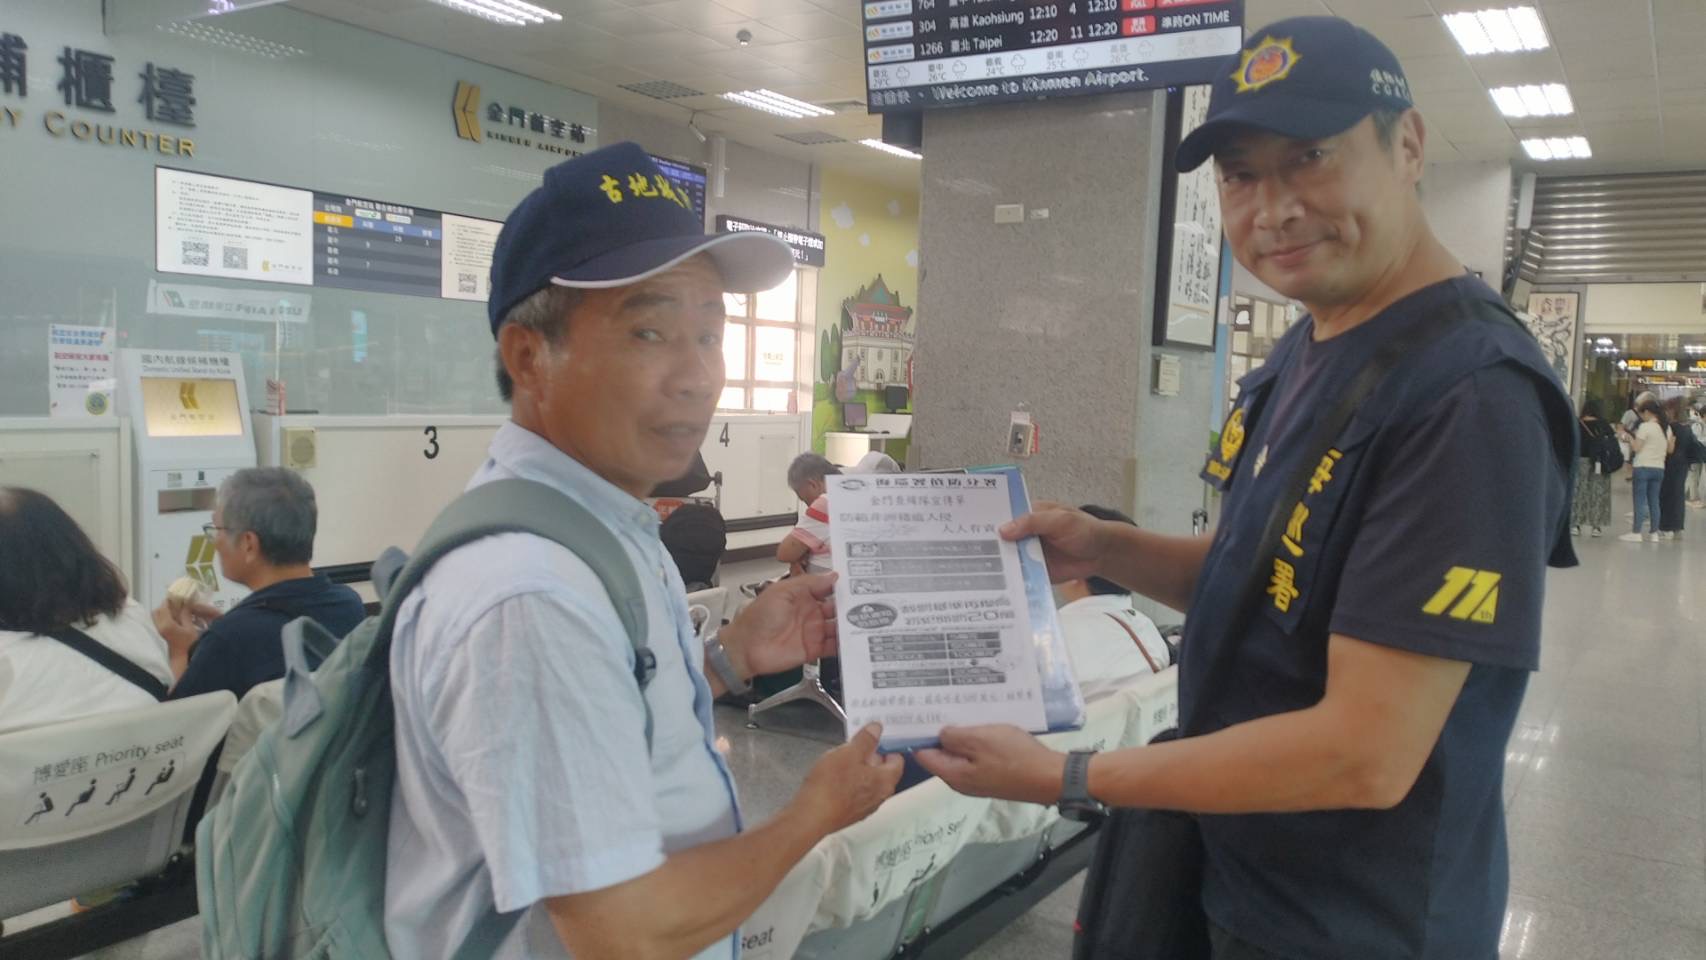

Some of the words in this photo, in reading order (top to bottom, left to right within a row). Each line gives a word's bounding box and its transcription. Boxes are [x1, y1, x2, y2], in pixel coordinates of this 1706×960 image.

[919, 19, 937, 33] 304
[972, 10, 1024, 27] Kaohsiung
[1029, 4, 1058, 20] 12:10
[1069, 4, 1077, 15] 4
[1088, 0, 1117, 13] 12:10
[920, 41, 943, 56] 1266
[973, 35, 1002, 51] Taipei
[1030, 28, 1059, 44] 12:20
[1071, 26, 1083, 39] 11
[1088, 21, 1117, 36] 12:20
[1203, 10, 1230, 25] TIME
[931, 83, 999, 101] Welcome
[1002, 80, 1019, 94] to
[1022, 75, 1081, 93] Kinmen
[1084, 67, 1149, 88] Airport.
[44, 110, 196, 158] COUNTER
[423, 425, 440, 460] 3
[719, 422, 730, 448] 4
[33, 755, 89, 784] 博愛座
[95, 746, 151, 768] Priority
[155, 736, 185, 754] seat
